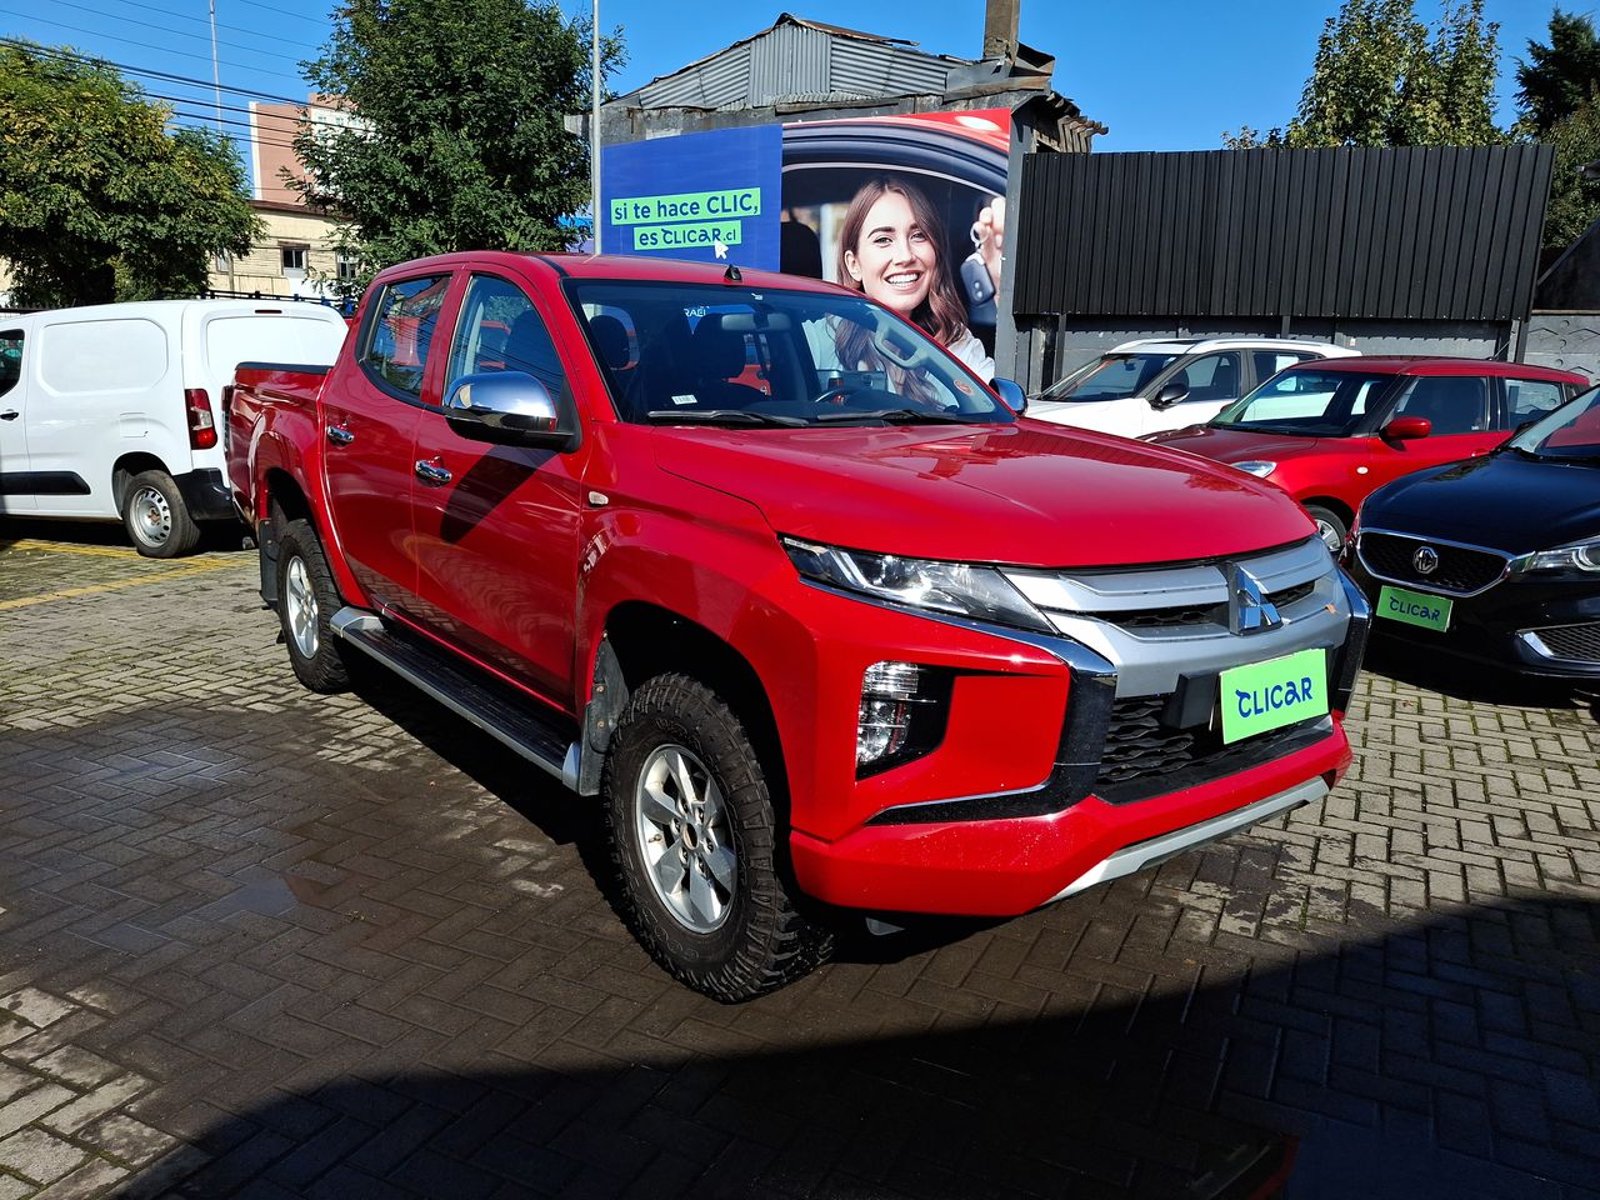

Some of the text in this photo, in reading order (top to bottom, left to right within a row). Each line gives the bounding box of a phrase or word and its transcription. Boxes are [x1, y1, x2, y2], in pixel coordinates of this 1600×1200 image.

[614, 193, 759, 220] si te hace CLIC,
[639, 232, 659, 246] es
